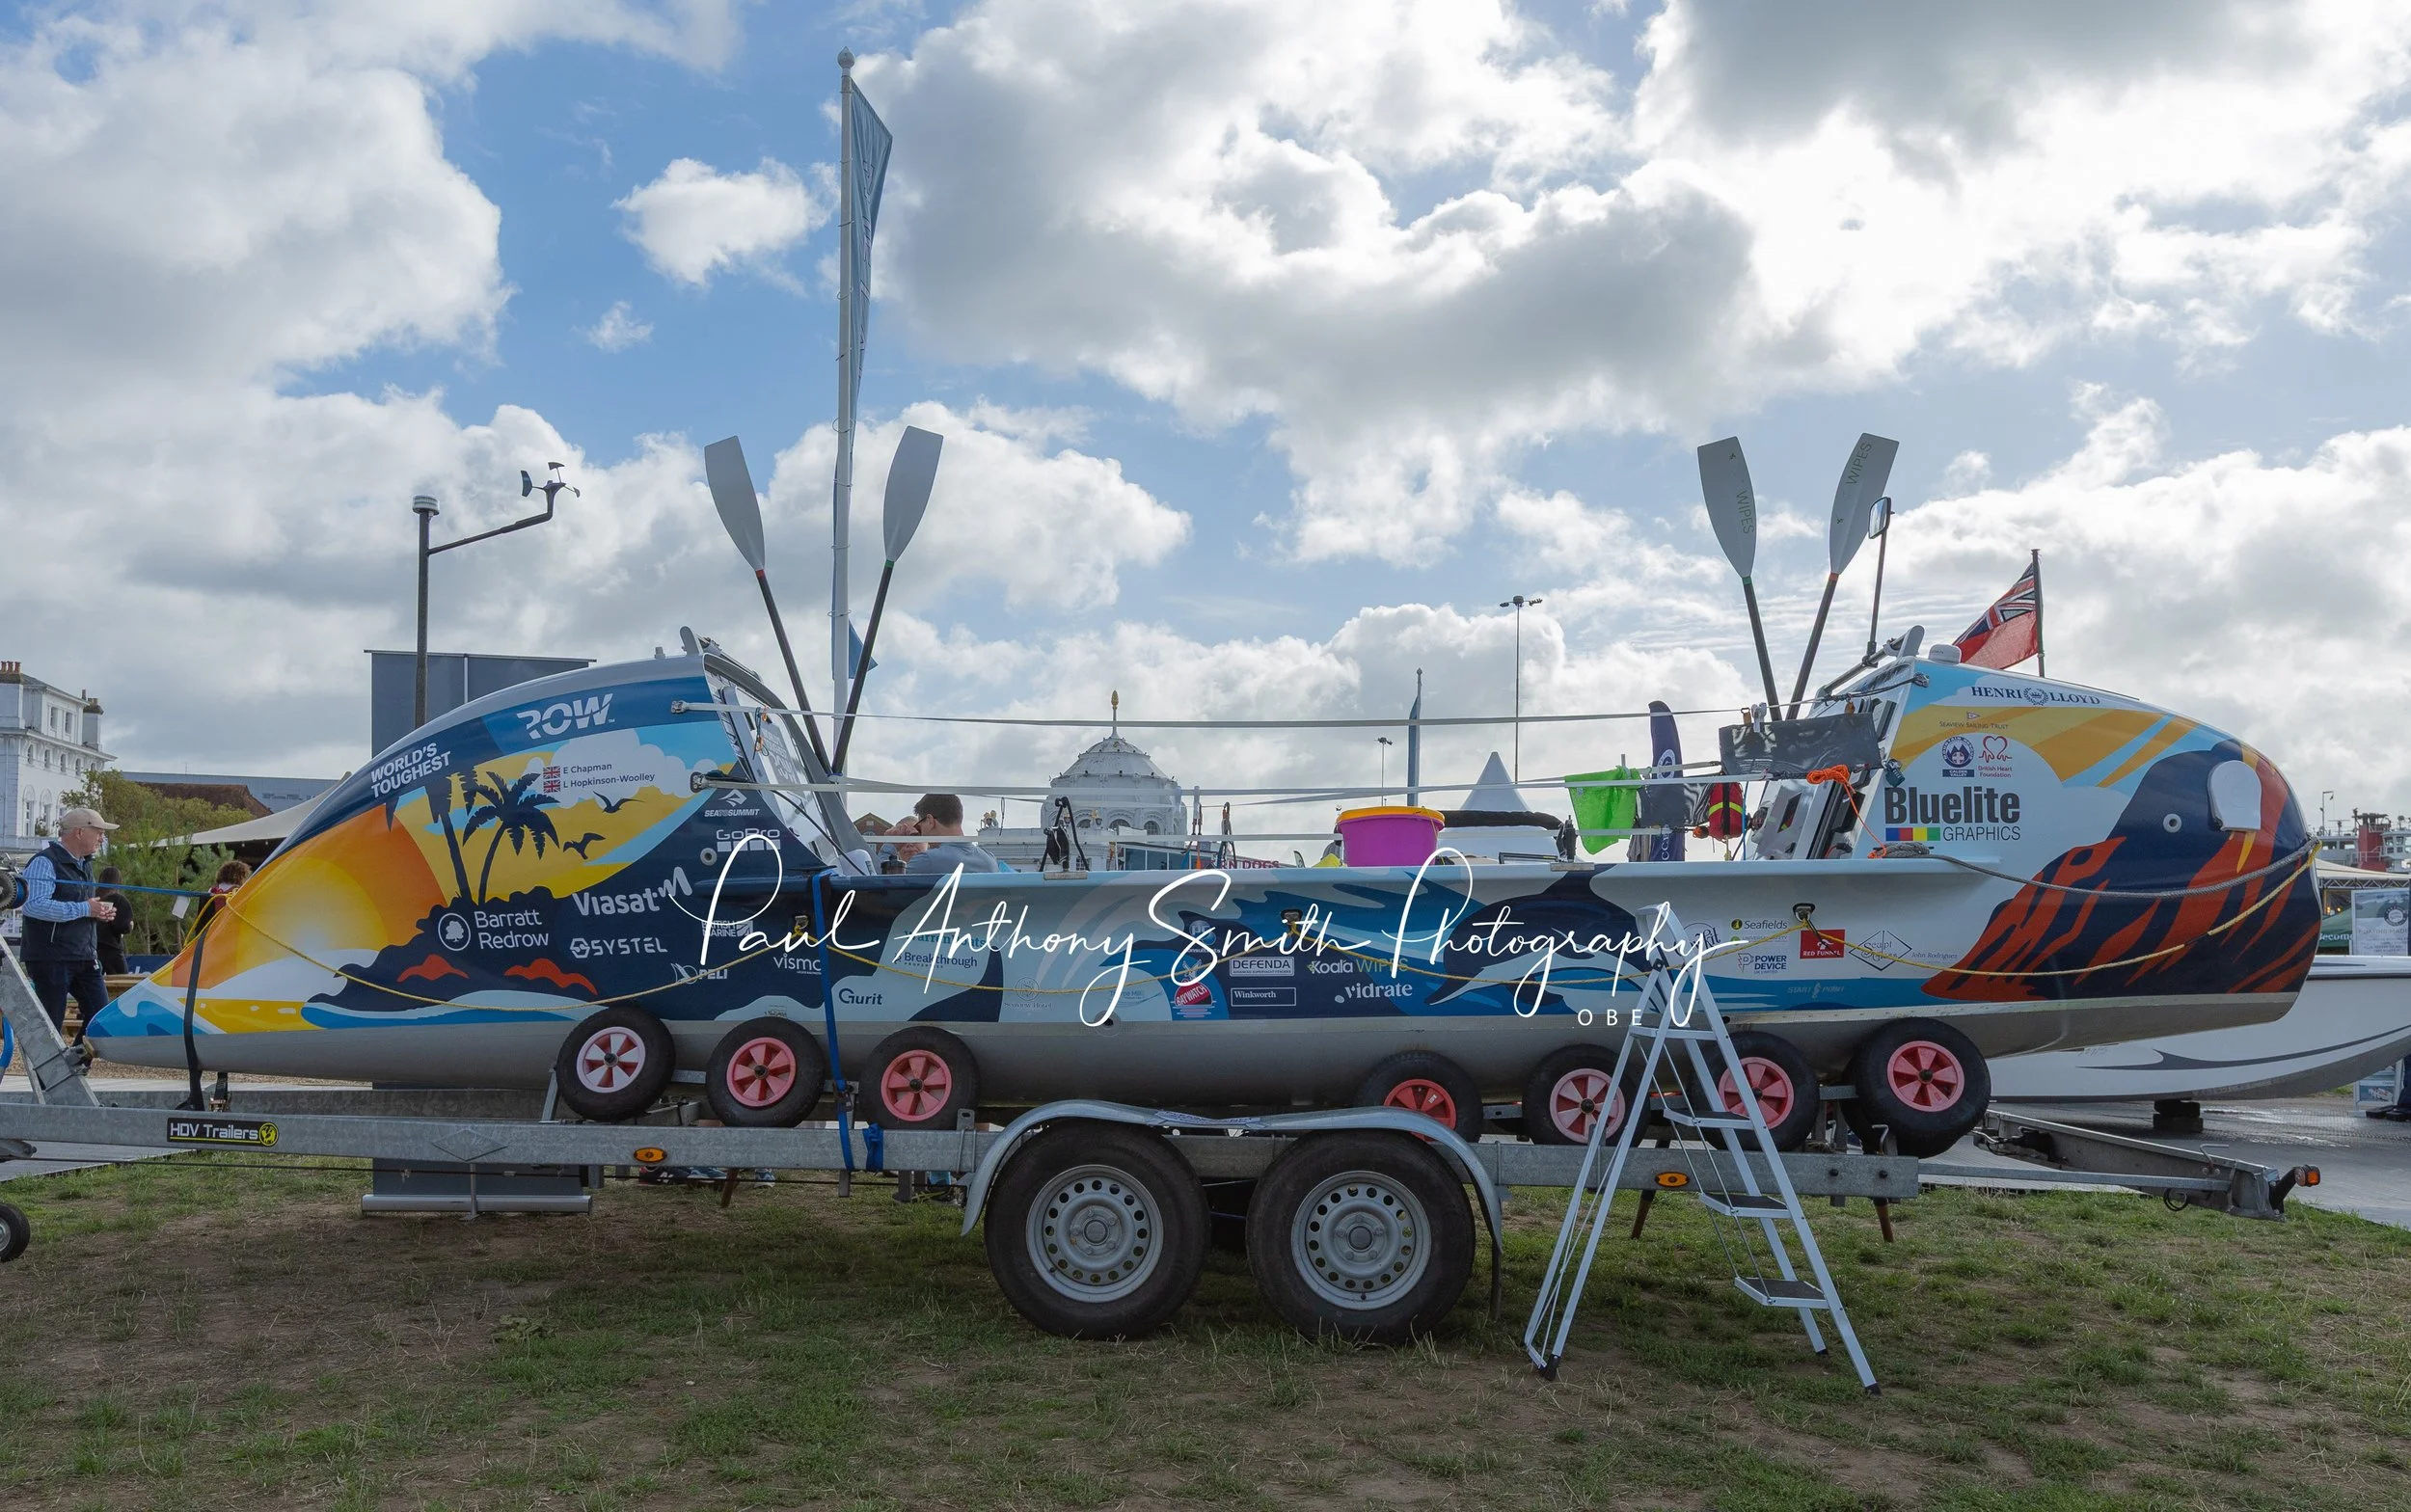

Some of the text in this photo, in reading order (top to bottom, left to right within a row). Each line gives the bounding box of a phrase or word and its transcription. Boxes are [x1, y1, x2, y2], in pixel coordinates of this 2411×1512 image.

[1846, 443, 1872, 484] WIPES
[1736, 490, 1754, 534] WIPES
[1971, 687, 2100, 705] HENRI LLOYD
[516, 693, 613, 740] ROW
[370, 742, 438, 783] WORLD'S
[571, 763, 612, 775] Chapman
[370, 750, 451, 798] TOUGHEST
[570, 772, 656, 788] Hopkinson-Woolley
[1883, 786, 2020, 824] Bluelite
[717, 827, 780, 839] GoPro
[1942, 825, 2021, 842] GRAPHICS
[571, 886, 661, 916] Viasat
[474, 909, 543, 929] Barratt
[1744, 919, 1788, 930] Seafields
[478, 932, 550, 950] Redrow
[591, 936, 668, 957] SYSTEL
[1233, 959, 1291, 969] DEFENDA
[1312, 958, 1409, 974] Koala WIPS
[699, 968, 728, 980] PELI
[838, 987, 882, 1006] Gurit
[1176, 985, 1208, 1006] BAYWATCH
[1233, 990, 1277, 999] Winkworth
[1344, 983, 1413, 999] vidrate
[170, 1122, 258, 1140] HDV Trailers
